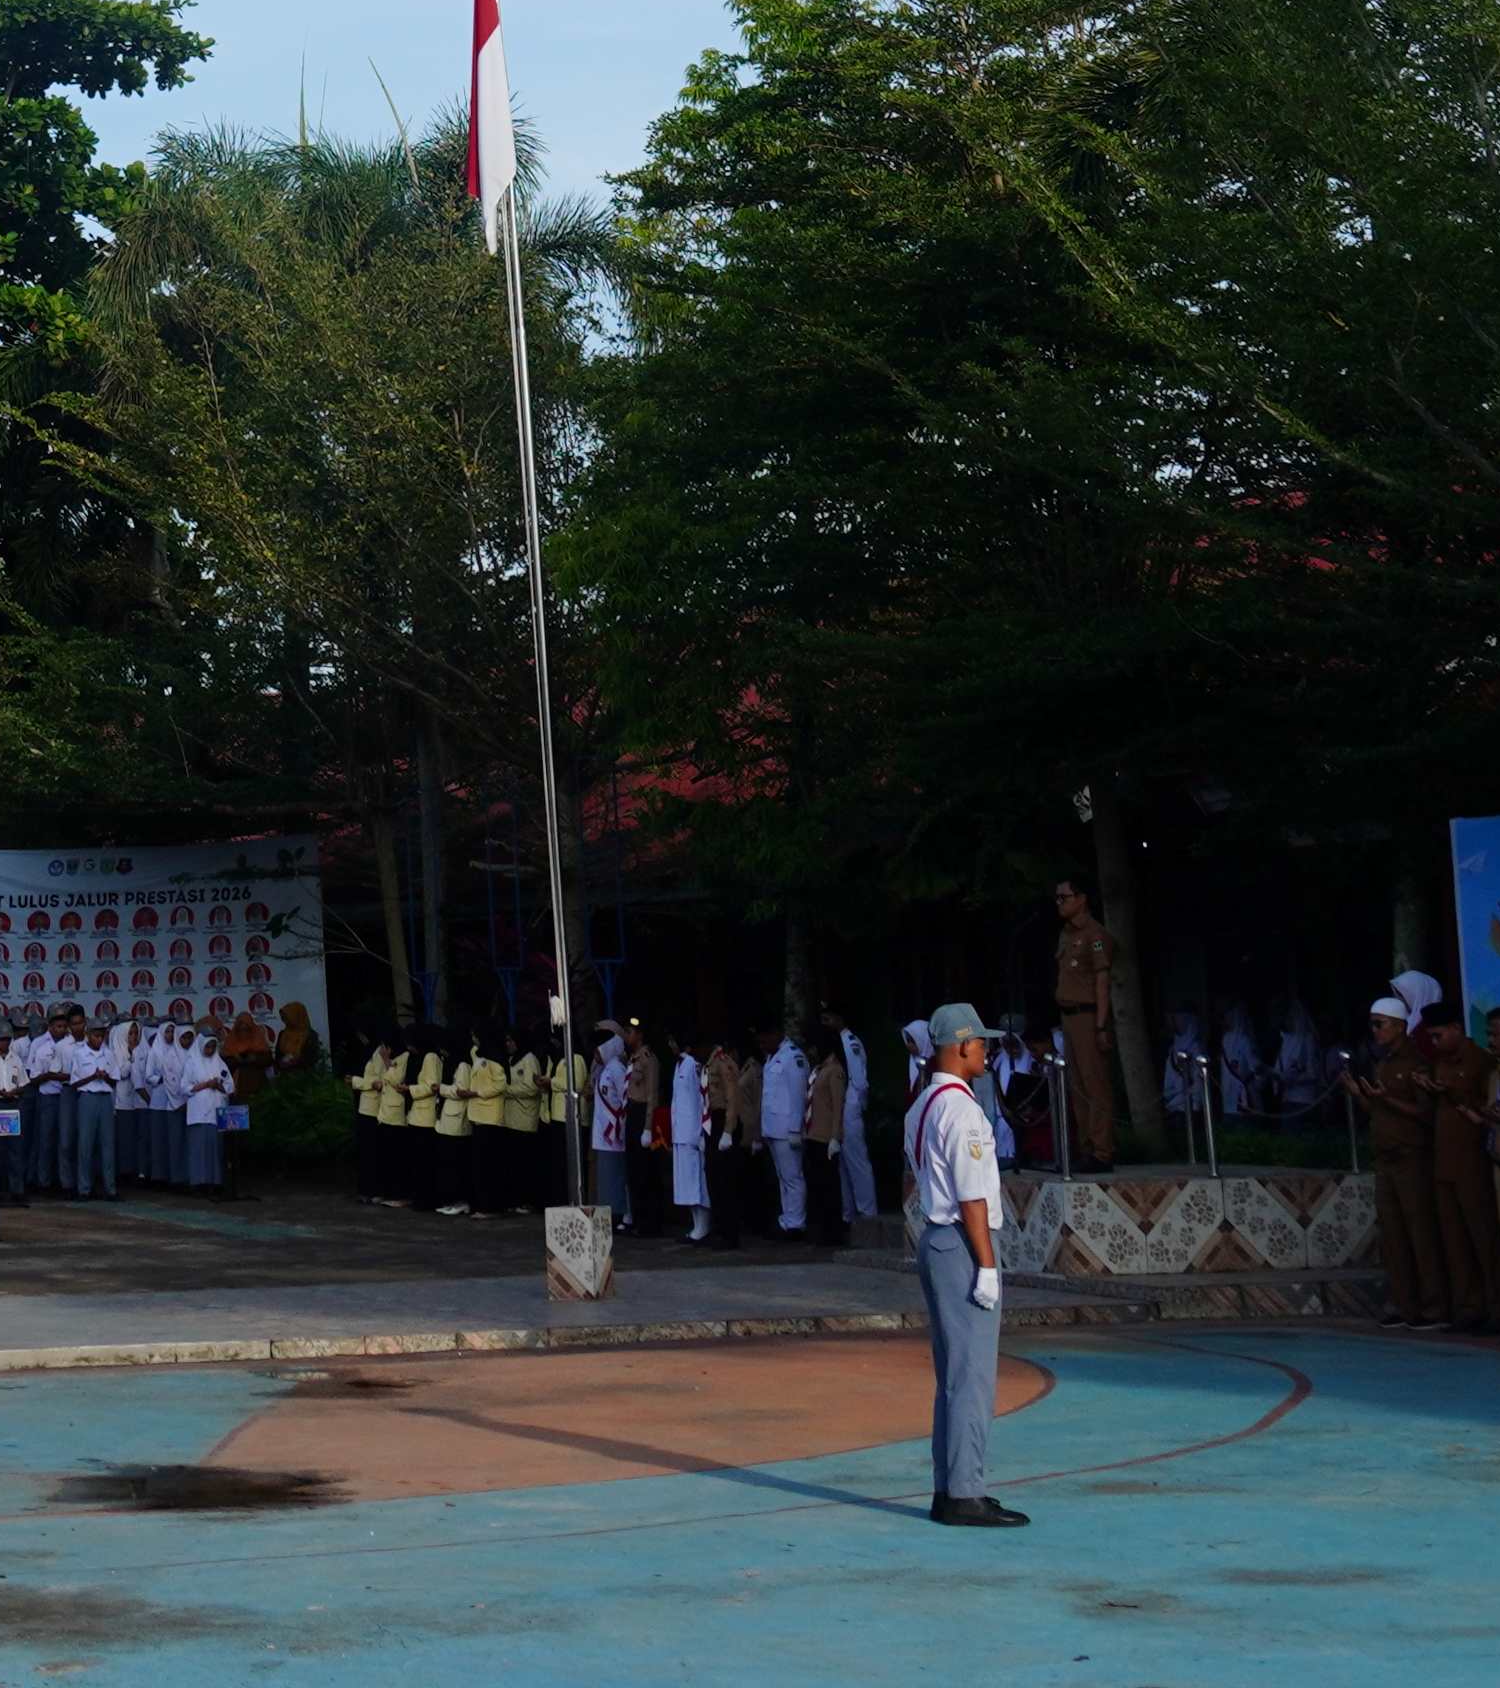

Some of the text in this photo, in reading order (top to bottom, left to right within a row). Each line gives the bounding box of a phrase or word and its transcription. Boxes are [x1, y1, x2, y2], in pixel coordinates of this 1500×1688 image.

[8, 893, 60, 909] LULUS
[64, 891, 120, 907] JALUR
[124, 889, 206, 905] PRESTASI
[211, 886, 252, 902] 2026
